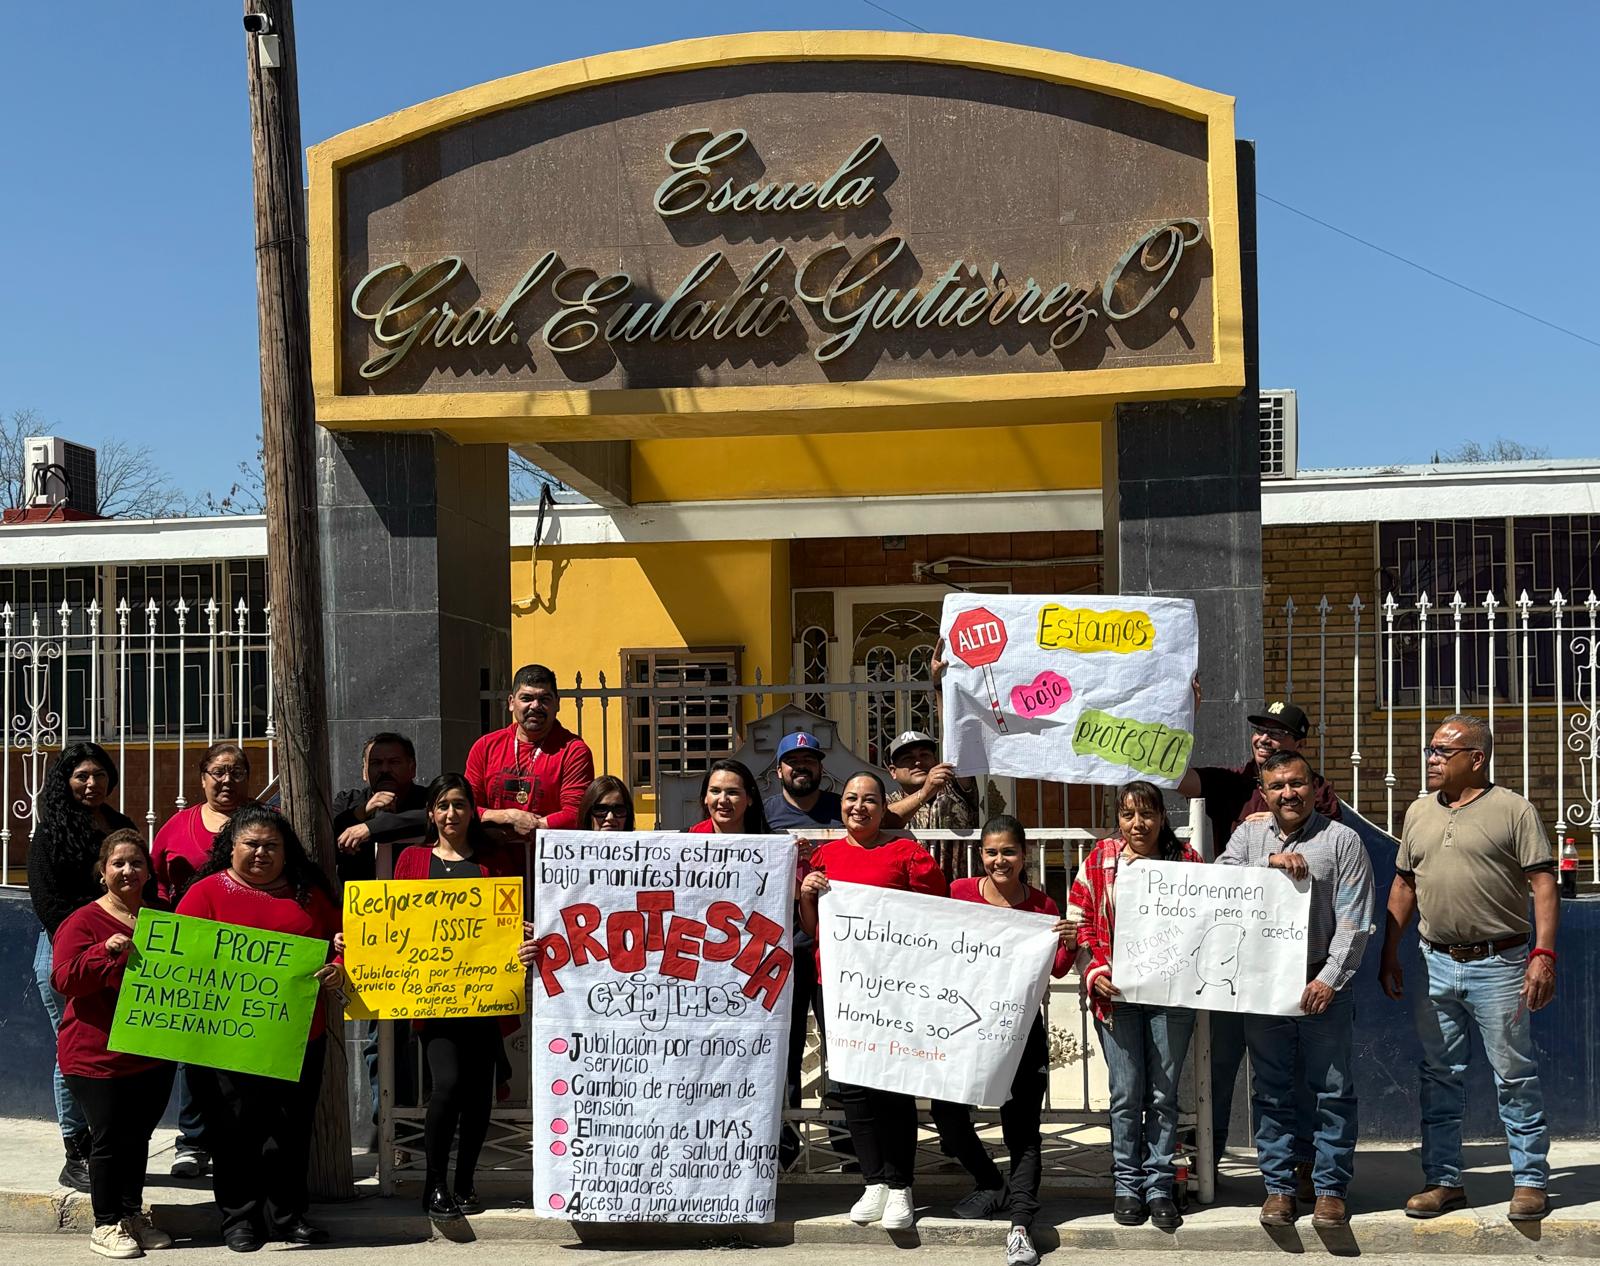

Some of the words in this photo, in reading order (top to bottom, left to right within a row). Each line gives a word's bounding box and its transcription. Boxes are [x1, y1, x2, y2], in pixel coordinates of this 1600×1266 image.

[652, 127, 883, 218] Escuela
[351, 250, 519, 380] Gral.
[542, 245, 792, 354] Eulalio
[1101, 217, 1202, 322] O.
[958, 621, 1001, 653] ALTO
[1039, 607, 1147, 647] Estamos
[1020, 680, 1063, 713] bajo
[1075, 719, 1184, 773] protesta
[539, 837, 575, 860] Los
[580, 840, 671, 862] maestros
[680, 840, 764, 864] estamos
[541, 862, 579, 889] bajo
[589, 862, 740, 889] manifestación
[754, 869, 769, 896] y
[349, 883, 482, 921] Rechazamos
[1138, 904, 1149, 915] a
[1154, 897, 1196, 918] todos
[1214, 907, 1243, 921] pero
[1251, 909, 1267, 920] no
[145, 920, 184, 956] EL
[213, 928, 294, 967] PROFE
[361, 922, 377, 946] la
[385, 922, 411, 954] ley
[431, 917, 487, 942] ISSSTE
[833, 914, 938, 950] Jubilación
[951, 932, 1001, 964] digna
[1125, 924, 1185, 959] REFORMA
[407, 946, 454, 964] 2025
[535, 890, 793, 1012] PROTESTA
[429, 969, 449, 983] por
[453, 962, 497, 981] tiempo
[504, 956, 519, 973] de
[1160, 958, 1190, 982] 2025
[350, 980, 396, 993] servicio
[937, 988, 960, 1004] 28
[241, 999, 290, 1022] ESTA
[390, 1007, 408, 1017] 30
[413, 1007, 437, 1017] años
[416, 994, 457, 1009] mujeres
[471, 994, 478, 1006] y
[990, 1000, 1026, 1014] años
[837, 1002, 914, 1033] Hombres
[926, 1025, 950, 1040] 30
[999, 1015, 1013, 1028] de
[569, 1030, 657, 1062] Jubilación
[663, 1038, 692, 1065] por
[701, 1038, 747, 1057] años
[752, 1033, 772, 1057] de
[890, 1040, 947, 1061] Presente
[571, 1074, 637, 1098] Cambio
[643, 1076, 662, 1099] de
[667, 1077, 731, 1106] régimen
[737, 1077, 756, 1099] de
[577, 1117, 665, 1139] Eliminación
[670, 1123, 689, 1140] de
[695, 1119, 753, 1140] UMAS
[570, 1138, 639, 1158] Servicio
[651, 1142, 670, 1160] de
[682, 1141, 727, 1162] salud
[572, 1159, 597, 1176] sin
[603, 1158, 645, 1177] tocar
[650, 1160, 663, 1178] el
[669, 1161, 719, 1180] salario
[723, 1160, 742, 1179] de
[756, 1161, 775, 1180] los
[566, 1192, 623, 1214] Acceso
[631, 1197, 641, 1213] a
[649, 1198, 676, 1212] una
[679, 1194, 739, 1213] vivienda
[571, 1211, 598, 1222] con
[608, 1211, 668, 1223] créditos
